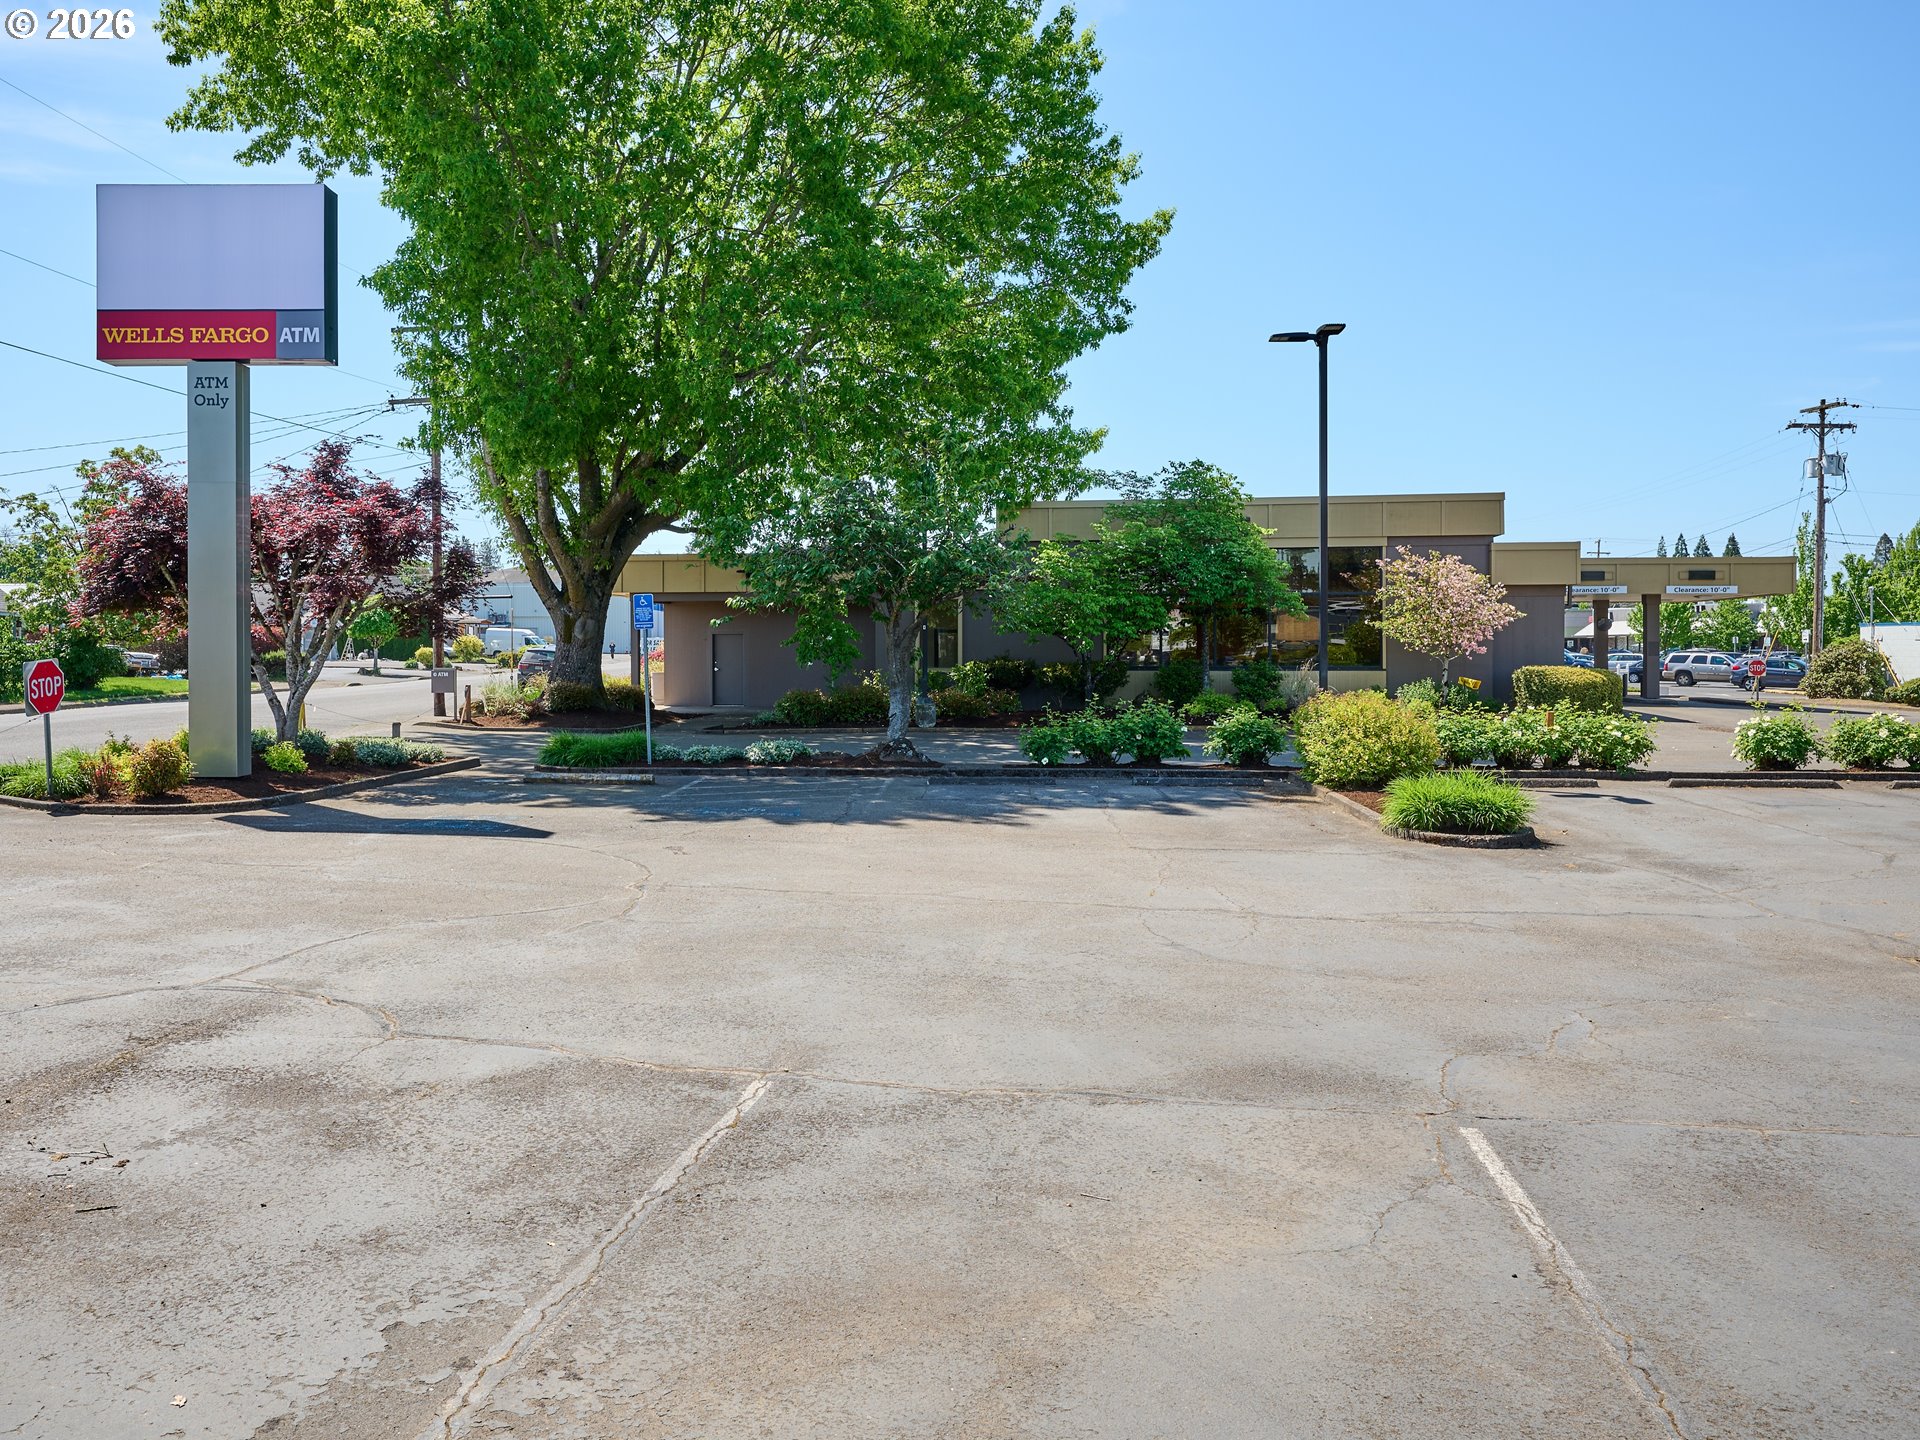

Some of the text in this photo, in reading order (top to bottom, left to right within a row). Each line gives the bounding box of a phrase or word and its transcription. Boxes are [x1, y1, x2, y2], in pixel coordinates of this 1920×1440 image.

[102, 327, 269, 343] WELLS FARGO
[279, 327, 320, 343] ATM
[194, 377, 229, 389] ATM
[194, 393, 229, 409] Only
[1749, 664, 1765, 672] STOP
[31, 676, 61, 699] STOP
